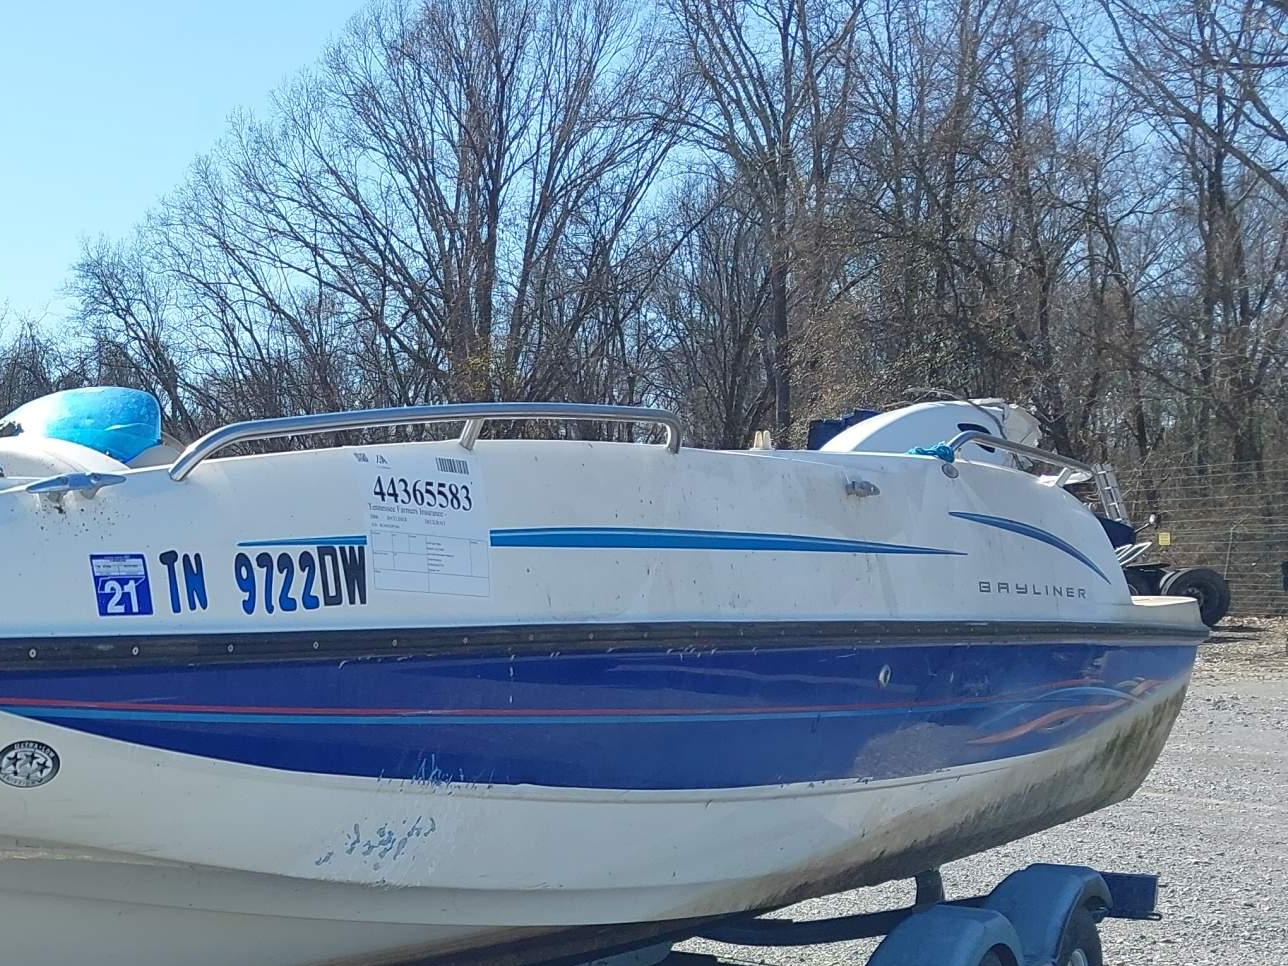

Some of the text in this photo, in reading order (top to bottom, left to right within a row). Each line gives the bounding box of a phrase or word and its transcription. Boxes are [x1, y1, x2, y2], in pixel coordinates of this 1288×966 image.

[373, 475, 472, 511] 44365583
[104, 580, 139, 613] 21
[159, 545, 367, 615] TN 9722DW
[978, 581, 1087, 600] BAYLINER
